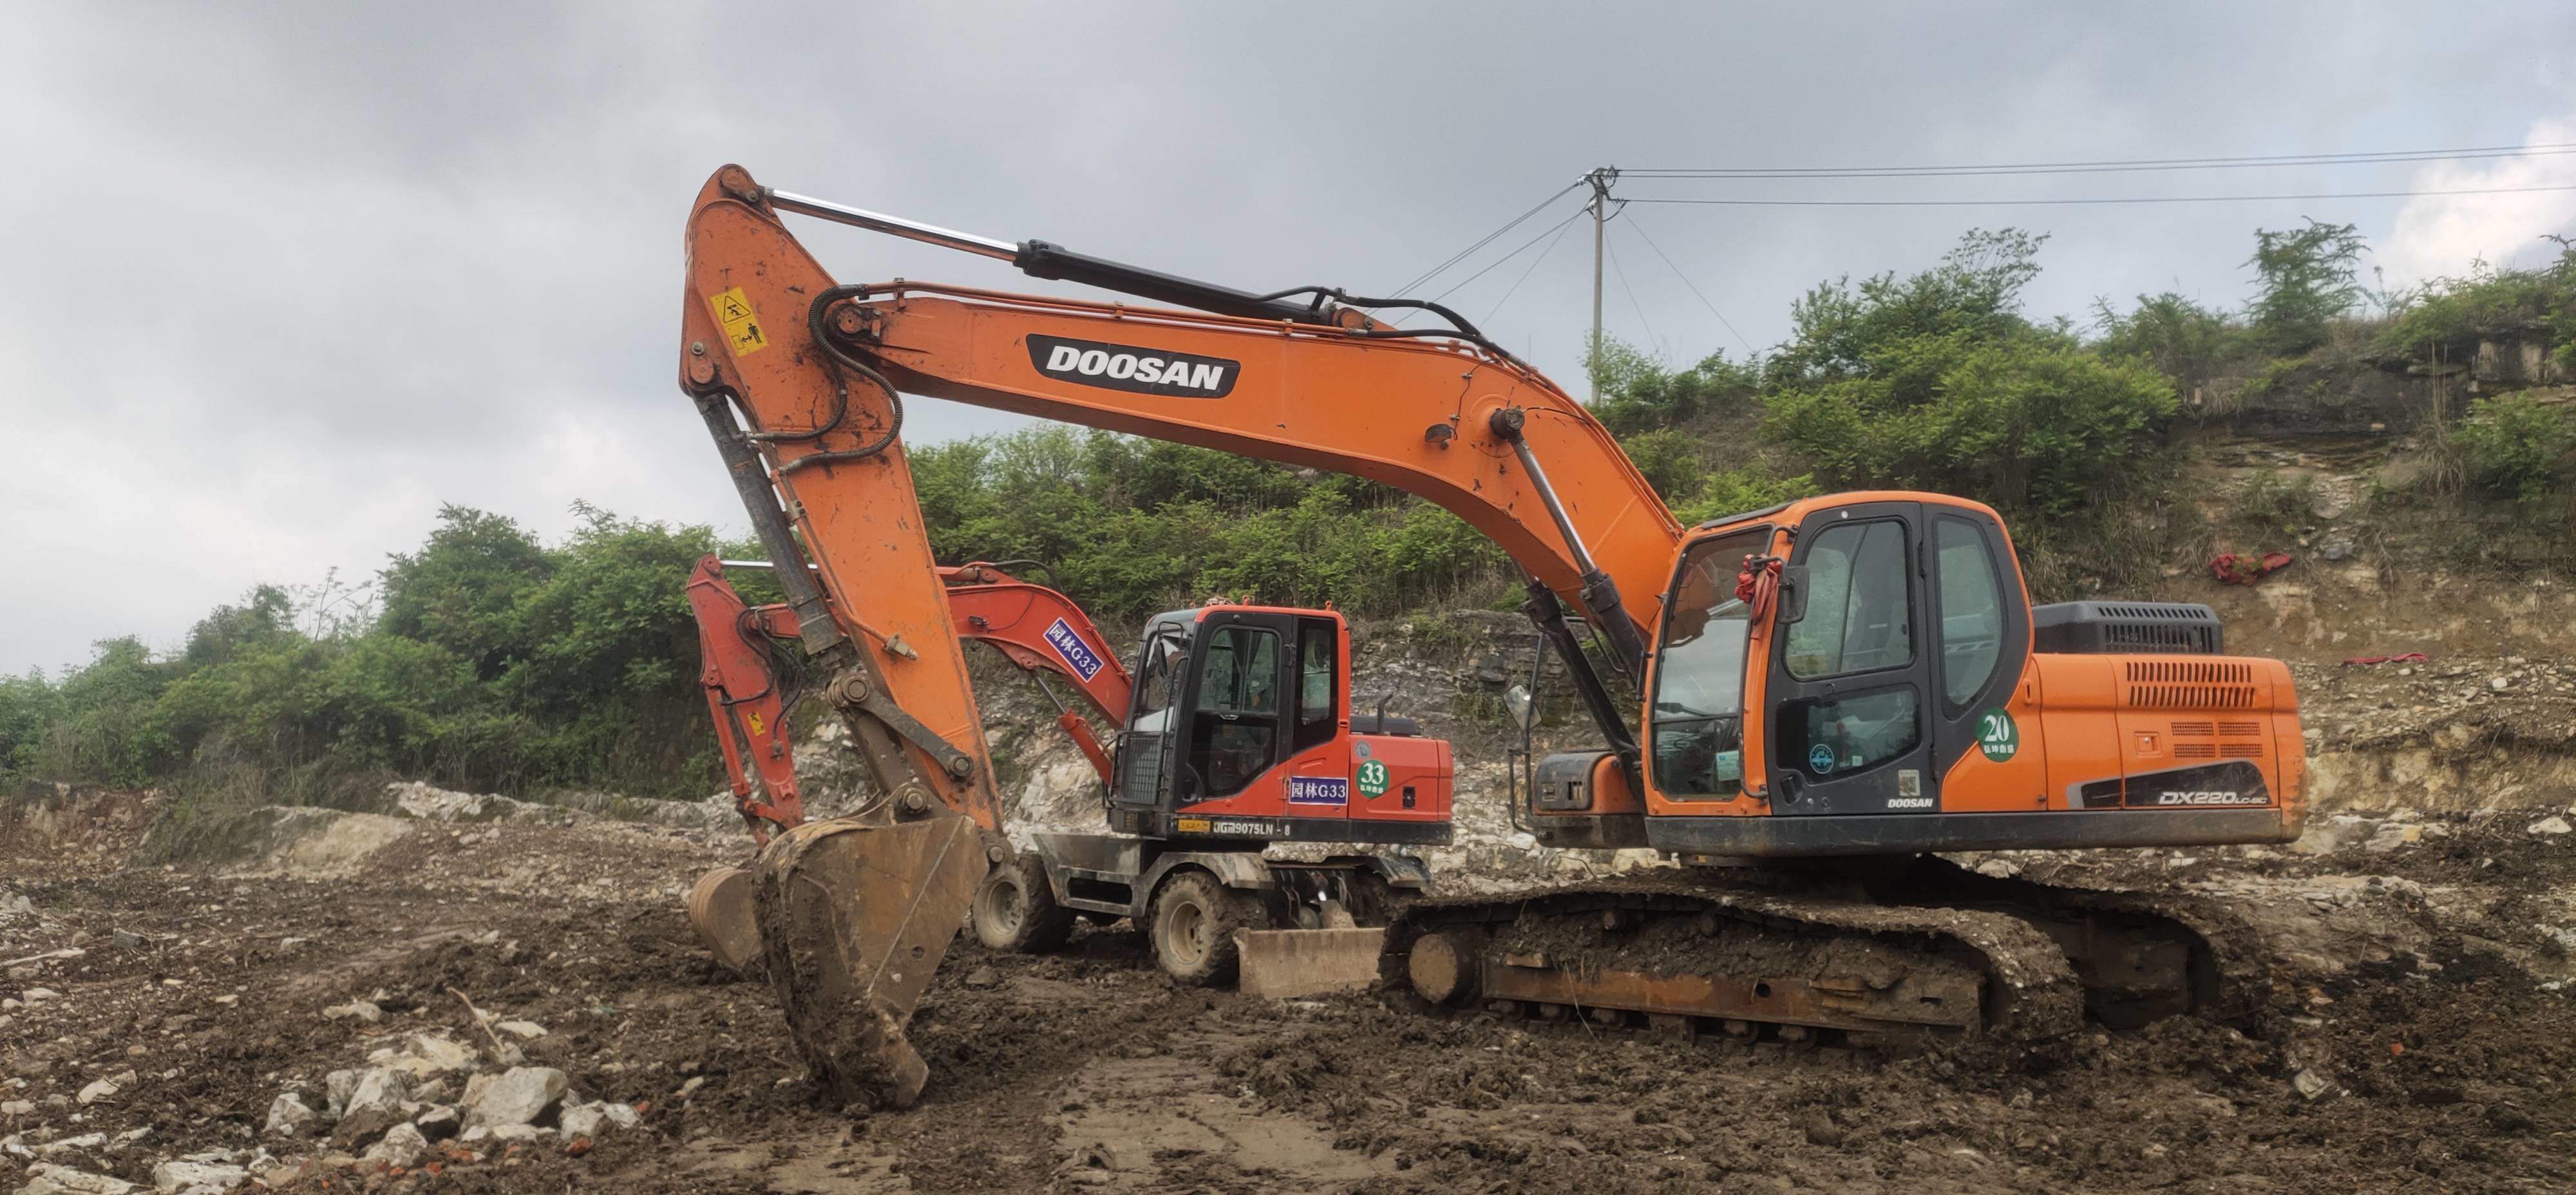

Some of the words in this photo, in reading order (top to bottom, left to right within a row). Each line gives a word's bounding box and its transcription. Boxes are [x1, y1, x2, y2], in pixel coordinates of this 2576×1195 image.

[1046, 346, 1224, 390] DOOSAN
[1048, 624, 1097, 674] 园林G33
[1984, 715, 2009, 742] 20
[1361, 763, 1384, 784] 33
[1291, 782, 1345, 798] 园林G33
[1888, 798, 1933, 808] DOOSAN
